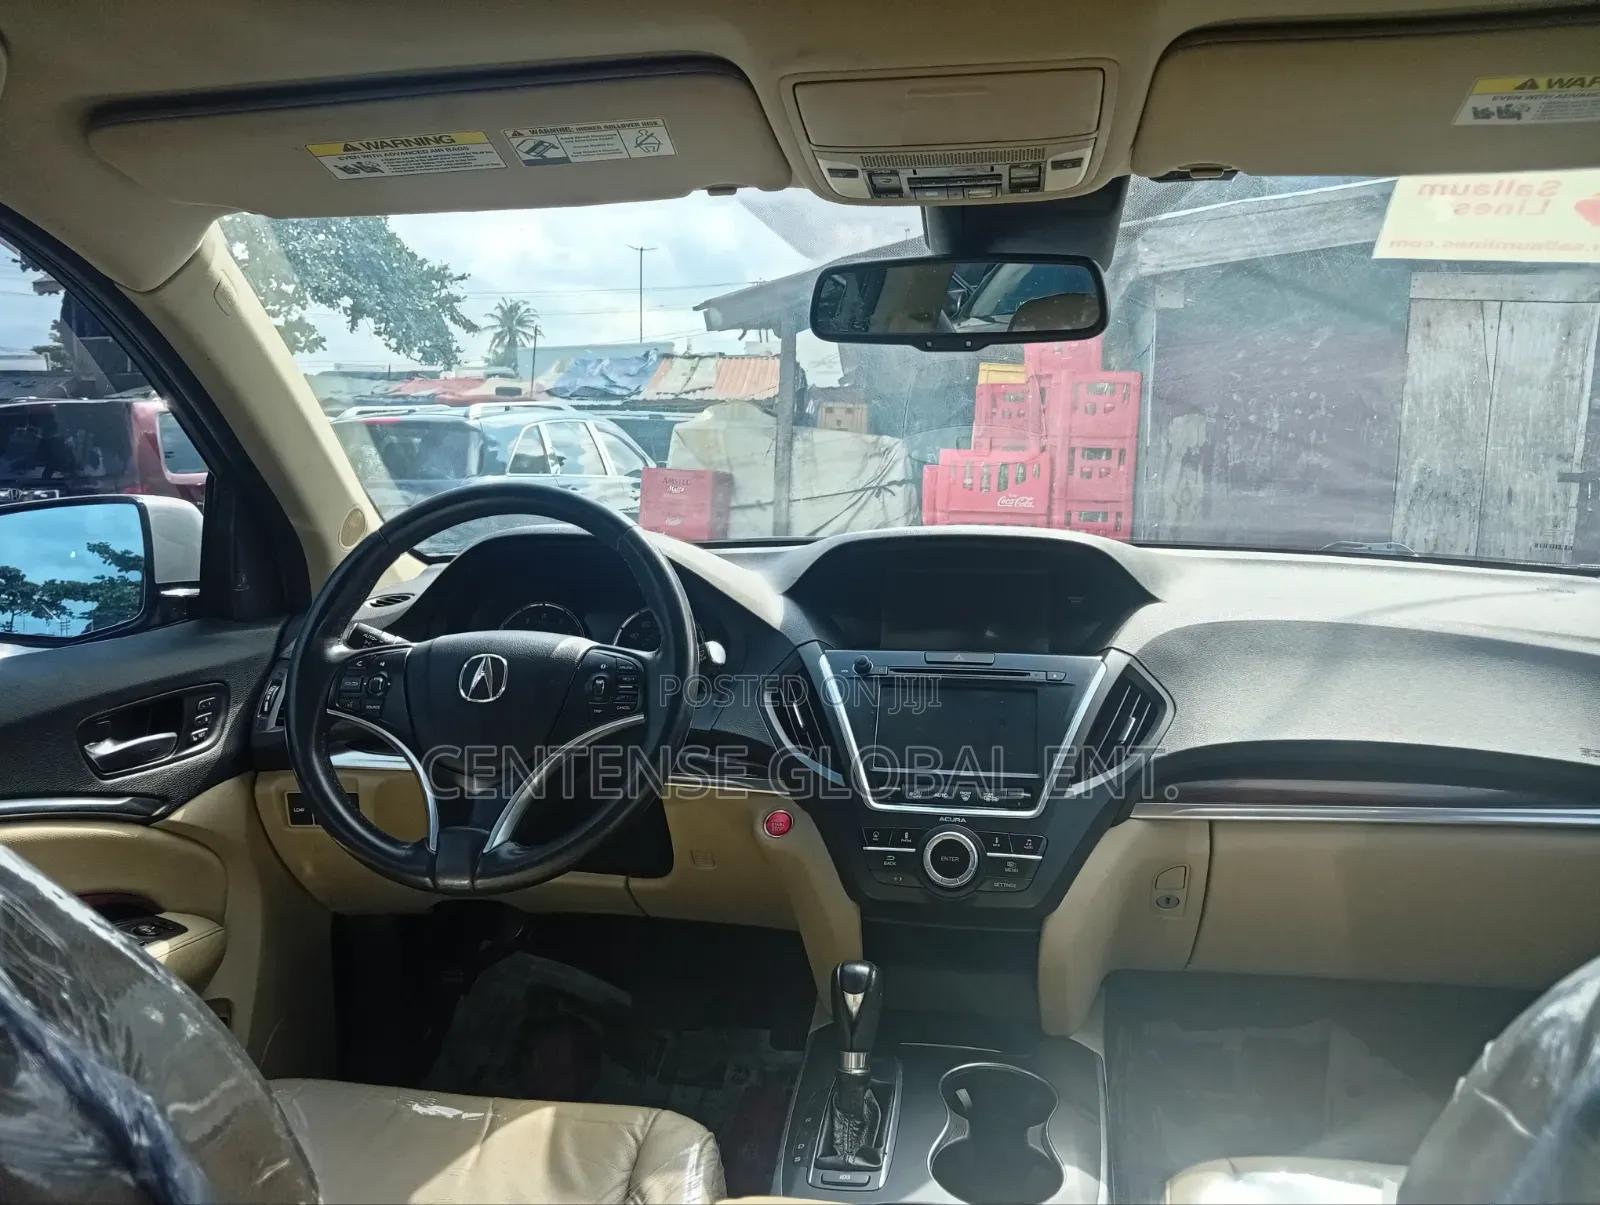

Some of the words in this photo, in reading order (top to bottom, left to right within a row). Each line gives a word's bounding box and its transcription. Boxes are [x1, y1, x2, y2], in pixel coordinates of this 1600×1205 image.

[528, 126, 574, 135] WARNING:
[575, 124, 602, 132] HIGHER
[603, 120, 641, 131] ROLLOVER
[358, 134, 456, 151] WARNING
[360, 152, 383, 160] WITH
[384, 149, 429, 158] ADVANCED
[445, 145, 470, 153] BAGS
[997, 495, 1035, 508] Coca-Cola
[938, 816, 967, 824] ACURA
